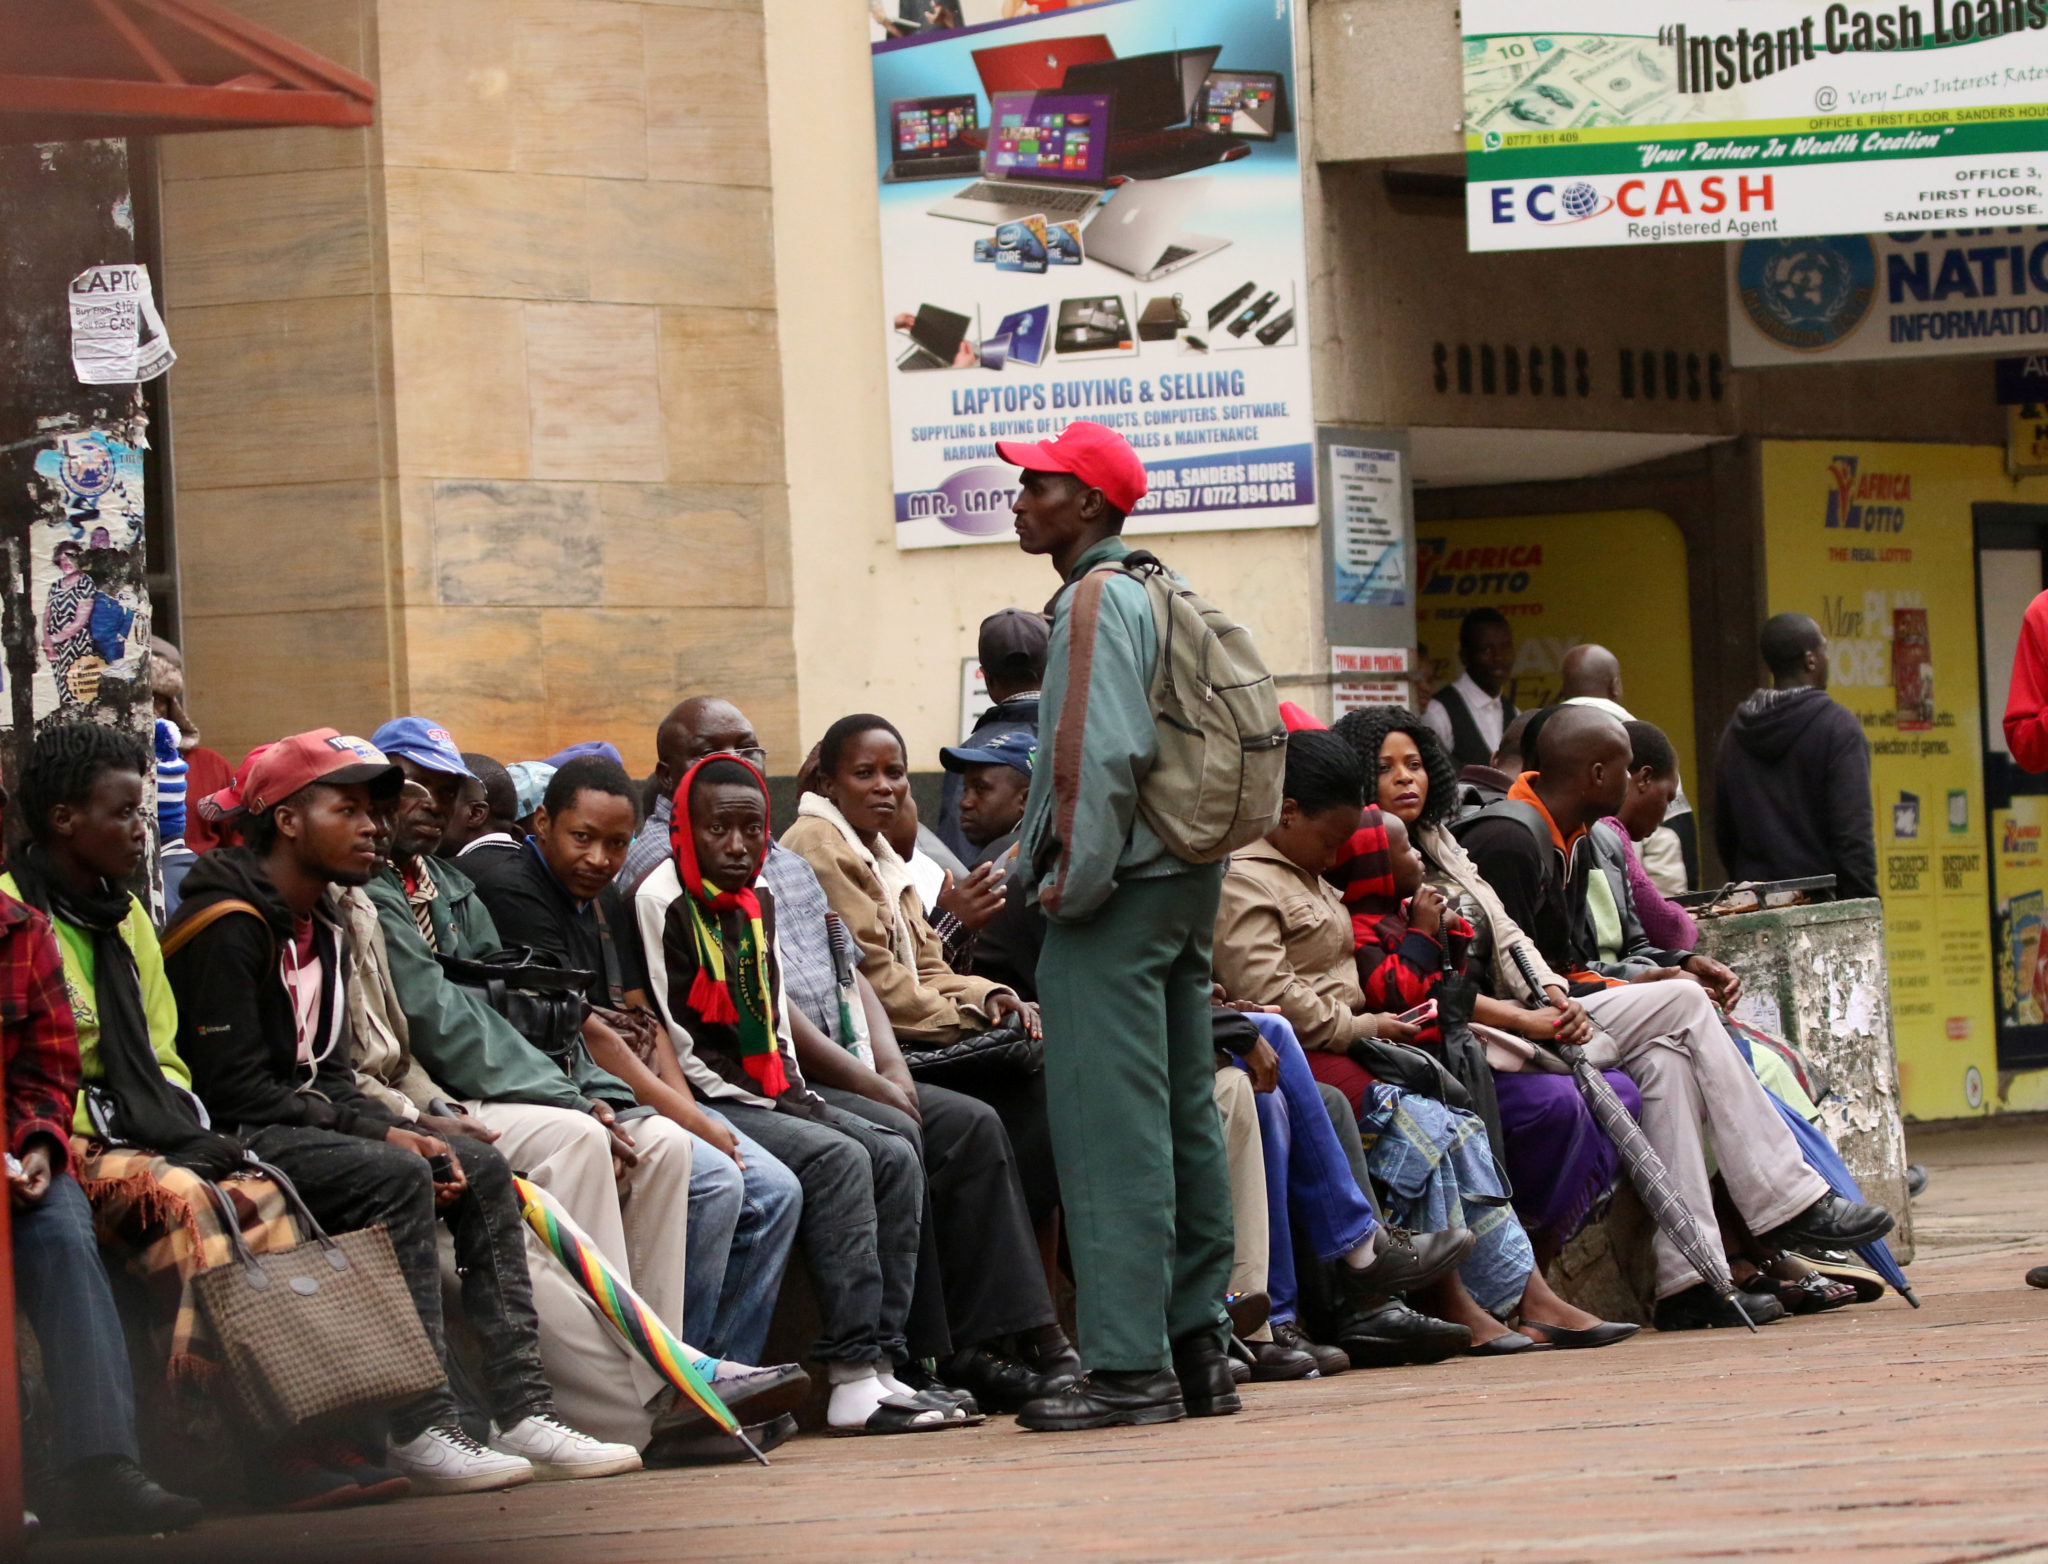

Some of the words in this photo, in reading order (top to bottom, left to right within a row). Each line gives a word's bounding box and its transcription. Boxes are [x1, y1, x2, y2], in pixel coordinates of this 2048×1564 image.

[1825, 3, 1924, 54] Cash
[1847, 88, 1888, 111] Very
[1892, 81, 1930, 100] Low
[1933, 71, 1999, 93] Interest
[1809, 116, 1852, 130] OFFICE
[1870, 114, 1904, 126] FIRST
[1956, 107, 2016, 121] SANDERS
[1690, 139, 1760, 162] Partner
[1762, 137, 1785, 159] In
[1790, 133, 1858, 157] Wealth
[1955, 169, 2020, 182] OFFICE
[1918, 188, 1970, 201] FIRST
[1976, 185, 2043, 200] FLOOR,
[1884, 207, 1968, 222] SANDERS
[1975, 203, 2043, 219] HOUSE.
[1628, 219, 1722, 240] Registered
[1727, 218, 1778, 237] Agent
[952, 383, 1047, 415] LAPTOPS
[1052, 376, 1133, 409] BUYING
[1139, 380, 1154, 403] &
[1160, 369, 1245, 401] SELLING
[979, 424, 987, 437] &
[990, 419, 1034, 437] BUYING
[1037, 418, 1050, 433] OF
[943, 442, 999, 462] HARDWA
[1164, 432, 1171, 446] &
[1175, 426, 1259, 446] MAINTENANCE
[1181, 464, 1246, 487] SANDERS
[1248, 461, 1296, 482] HOUSE
[1857, 472, 1912, 500] AFRICA
[908, 492, 957, 518] MR.
[963, 487, 1017, 513] LAPT
[1164, 488, 1191, 508] 957
[1203, 485, 1236, 506] 0772
[1239, 483, 1268, 504] 894
[1270, 481, 1297, 502] 041
[1444, 544, 1544, 570] AFRICA
[1829, 547, 1848, 562] THE
[1851, 547, 1877, 562] REAL
[1880, 547, 1912, 562] LOTTO
